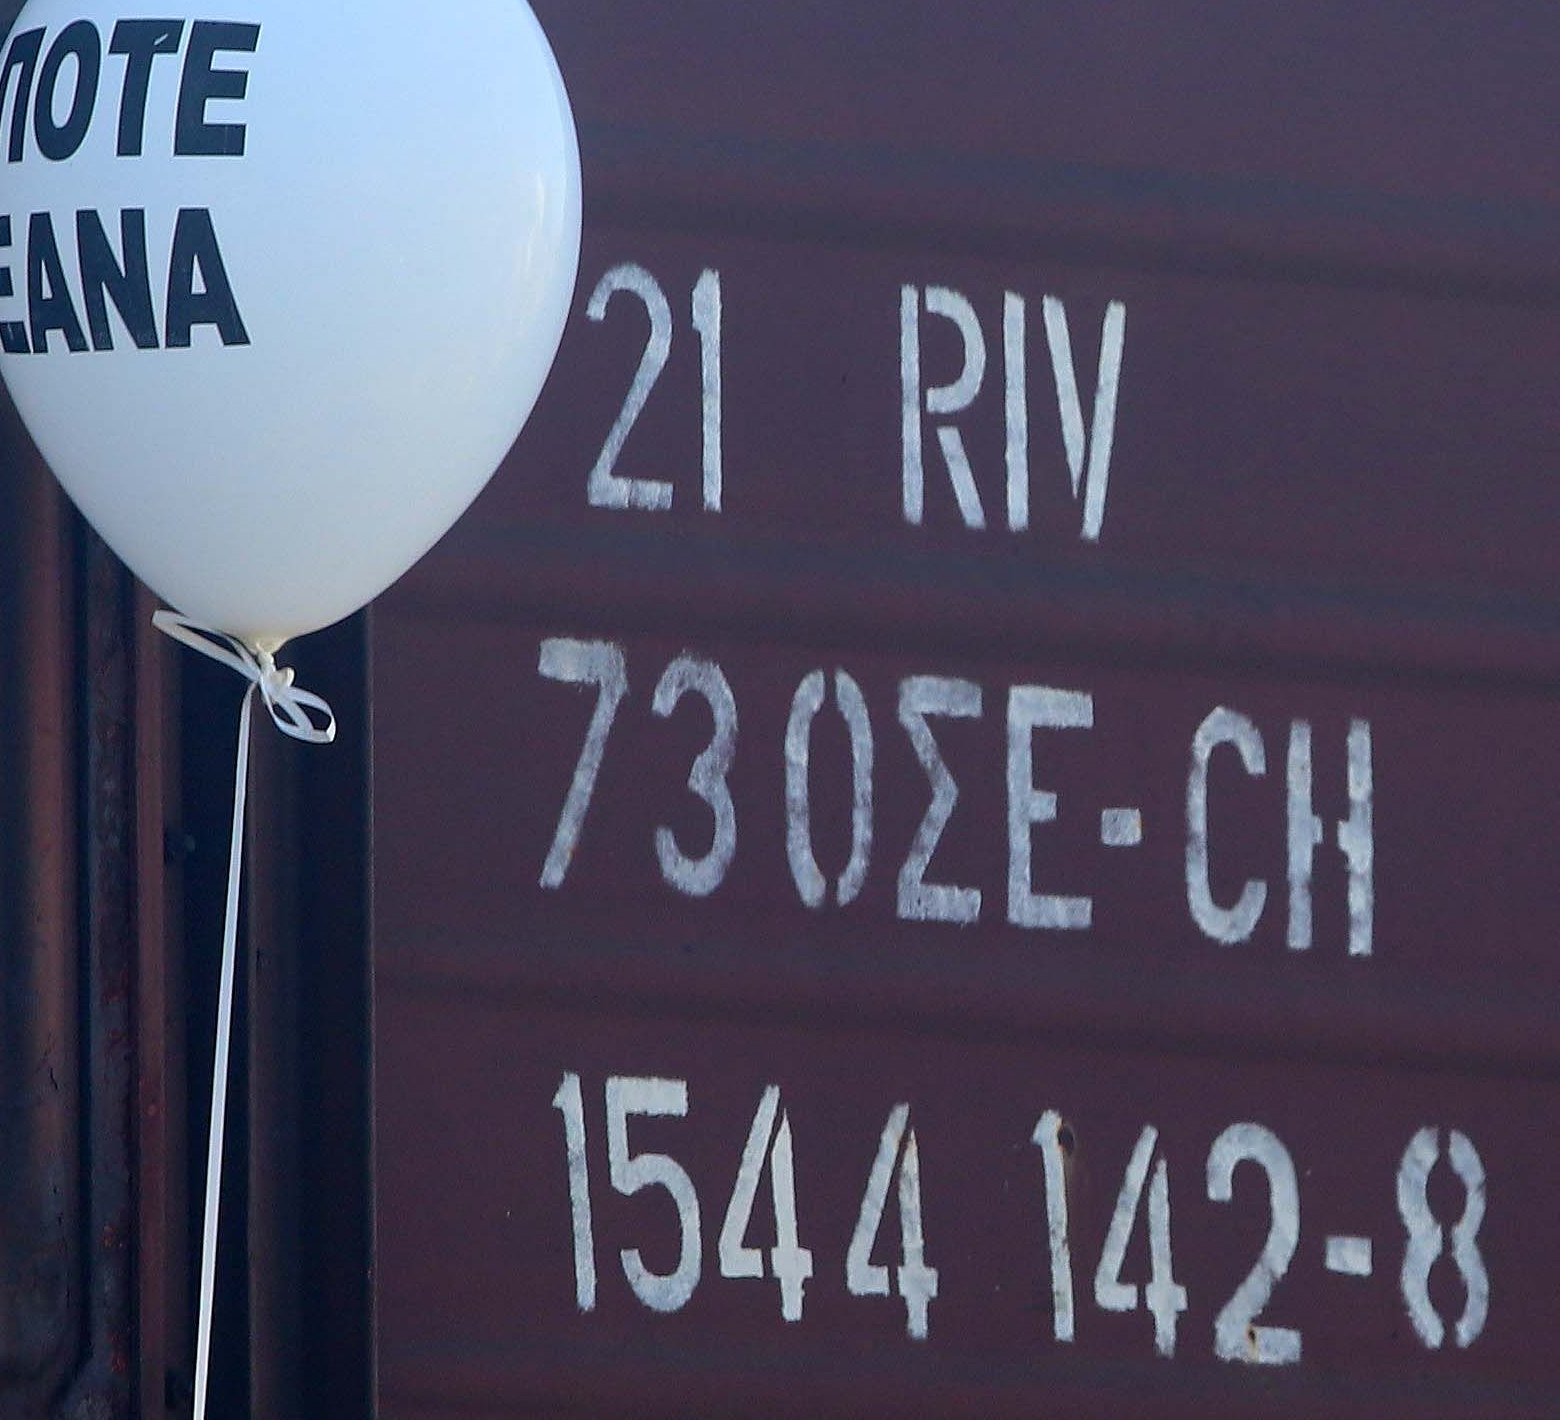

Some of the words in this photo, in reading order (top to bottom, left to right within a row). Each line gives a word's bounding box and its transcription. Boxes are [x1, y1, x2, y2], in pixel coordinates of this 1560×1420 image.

[586, 264, 723, 514] 21
[900, 283, 1126, 540] RIV
[552, 1071, 939, 1340] 1544
[1032, 1108, 1489, 1366] 142-8
